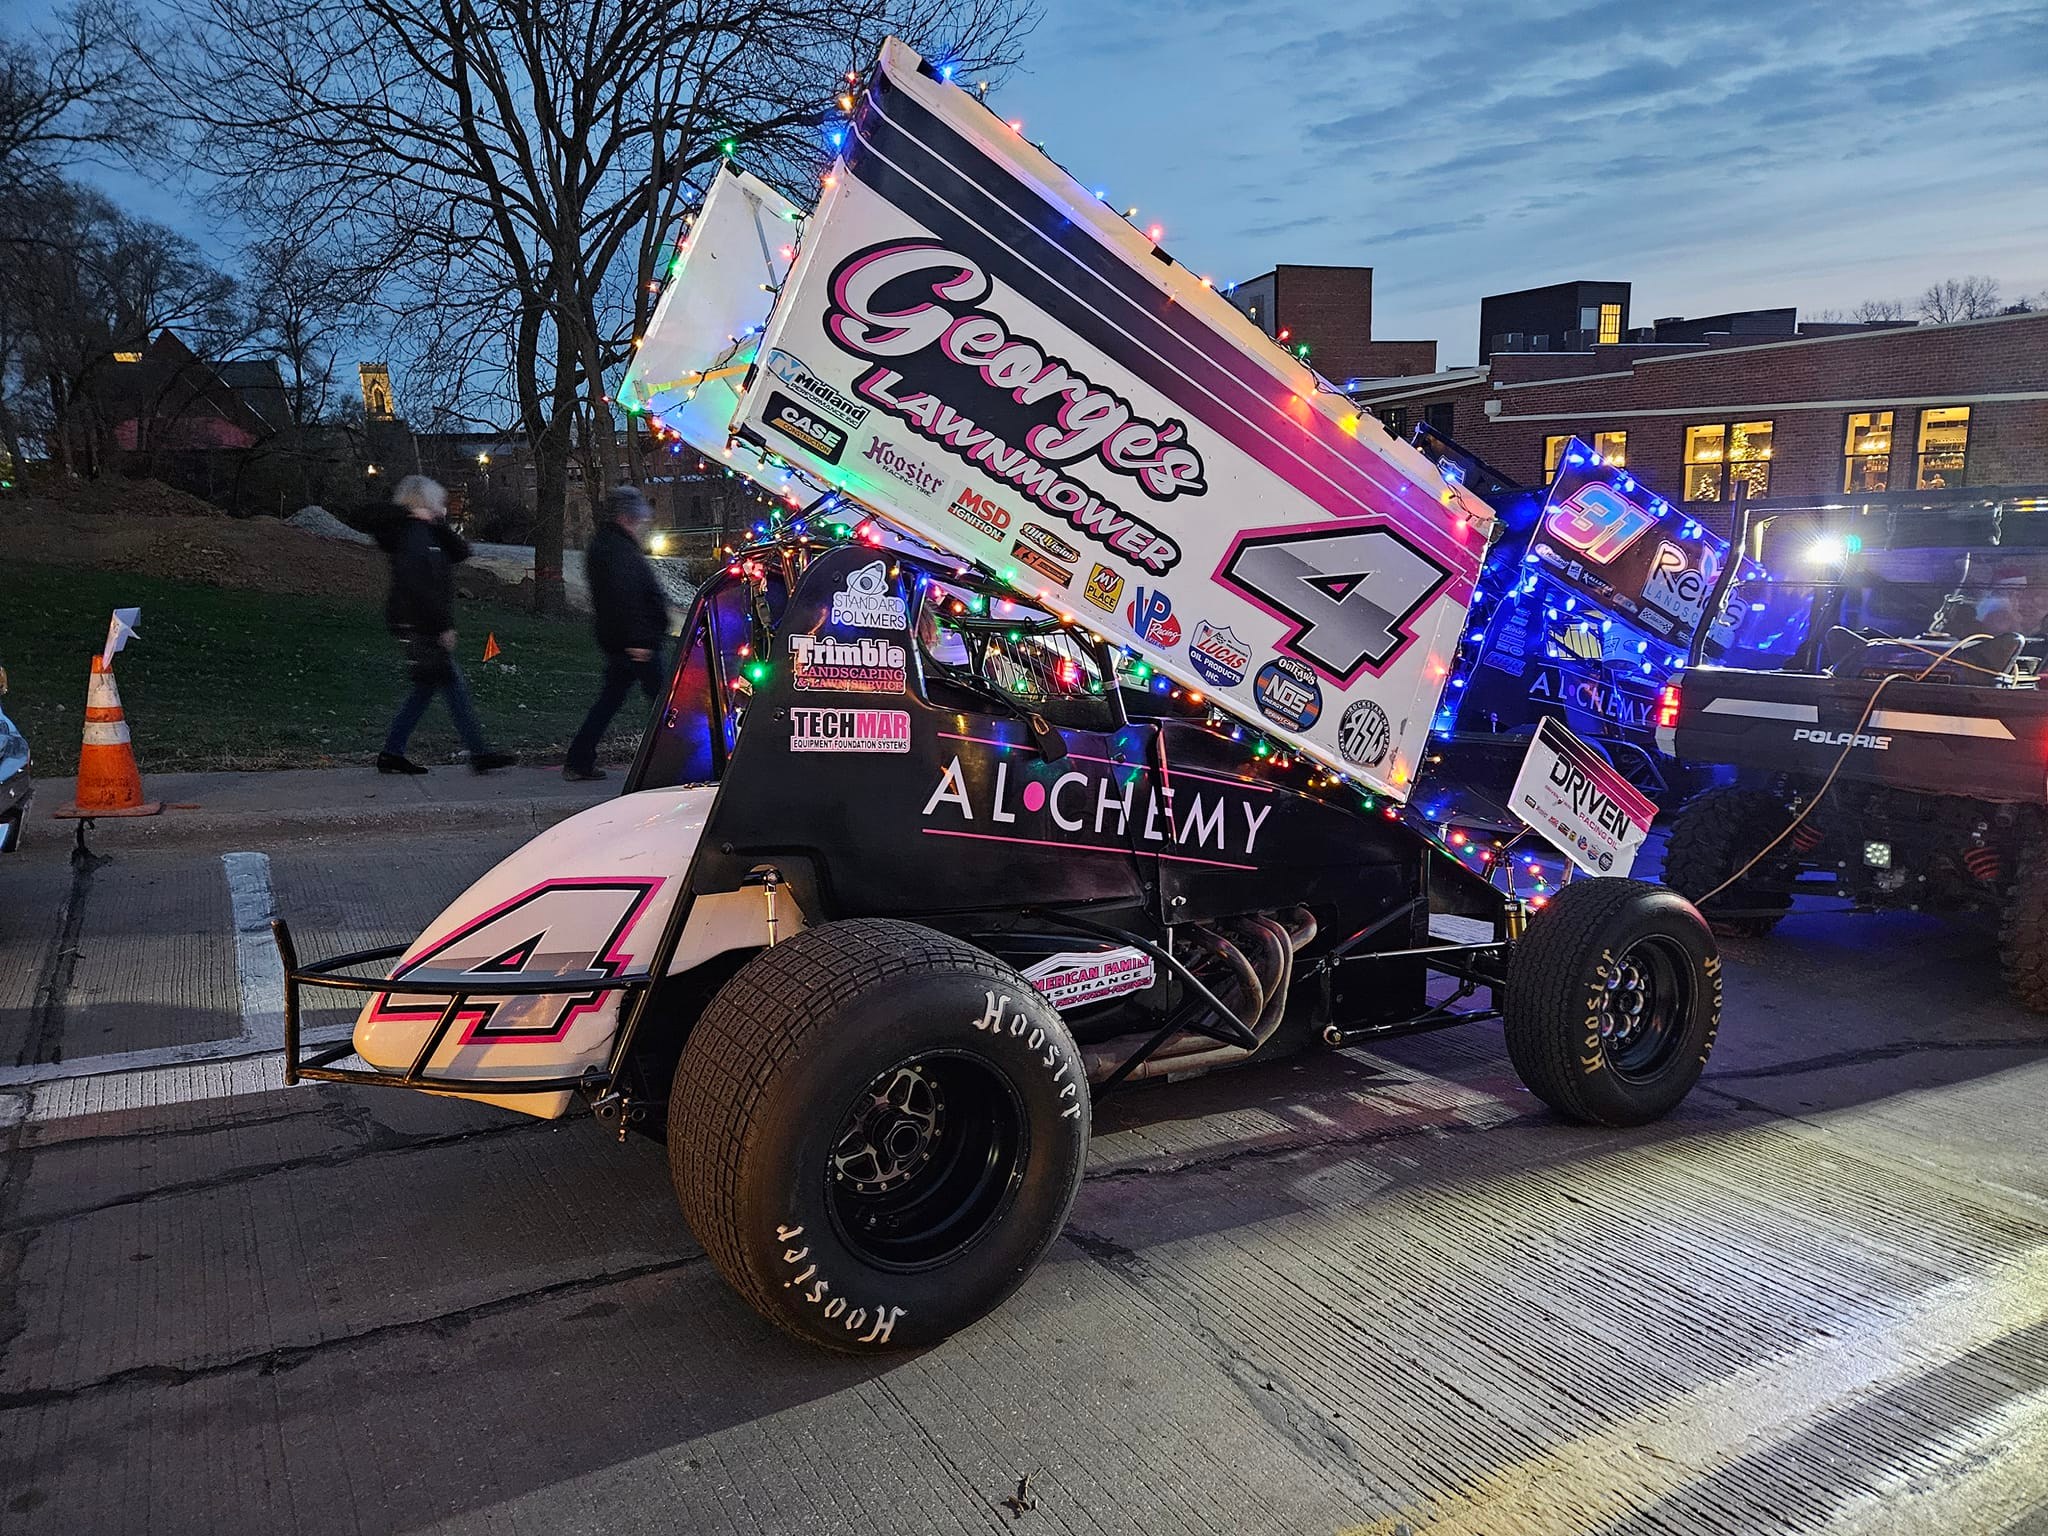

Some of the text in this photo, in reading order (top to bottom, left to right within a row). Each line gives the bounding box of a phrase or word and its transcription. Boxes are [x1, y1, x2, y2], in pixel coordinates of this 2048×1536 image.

[827, 239, 1204, 496] George's
[790, 382, 848, 420] PERFORMANCE
[794, 372, 868, 422] Midland
[781, 407, 842, 448] CASE
[783, 423, 831, 454] CONSTRUCTION
[857, 367, 1179, 572] LAWNMOWER
[862, 436, 945, 493] Hoosier
[882, 465, 932, 498] RACING TIRE
[952, 506, 1001, 540] IGNITION
[957, 487, 1011, 529] MSD
[1547, 483, 1659, 565] 31
[834, 594, 905, 613] STANDARD
[1087, 585, 1116, 607] PLACE
[1134, 586, 1171, 640] VP
[1218, 521, 1456, 684] 4
[833, 609, 906, 629] POLYMERS
[791, 637, 905, 671] Trimble
[1190, 650, 1241, 683] OIL PRODUCTS
[1197, 638, 1247, 668] LUCAS
[796, 676, 808, 688] &
[851, 679, 904, 691] SERVICE
[797, 666, 905, 681] LANDSCAPING
[1265, 674, 1312, 714] NOS
[793, 711, 908, 739] TECHMAR
[1793, 728, 1893, 750] POLARIS
[793, 739, 907, 750] EQUIPMENT FOUNDATION SYSTEMS
[1549, 755, 1632, 842] DRIVEN
[1578, 811, 1608, 840] RACING
[373, 880, 662, 1040] 4
[1032, 955, 1151, 991] MERICAN FAMILY
[1580, 948, 1615, 1075] Hoosier
[972, 989, 1081, 1120] Hoosier
[775, 1224, 908, 1344] Hoosier
